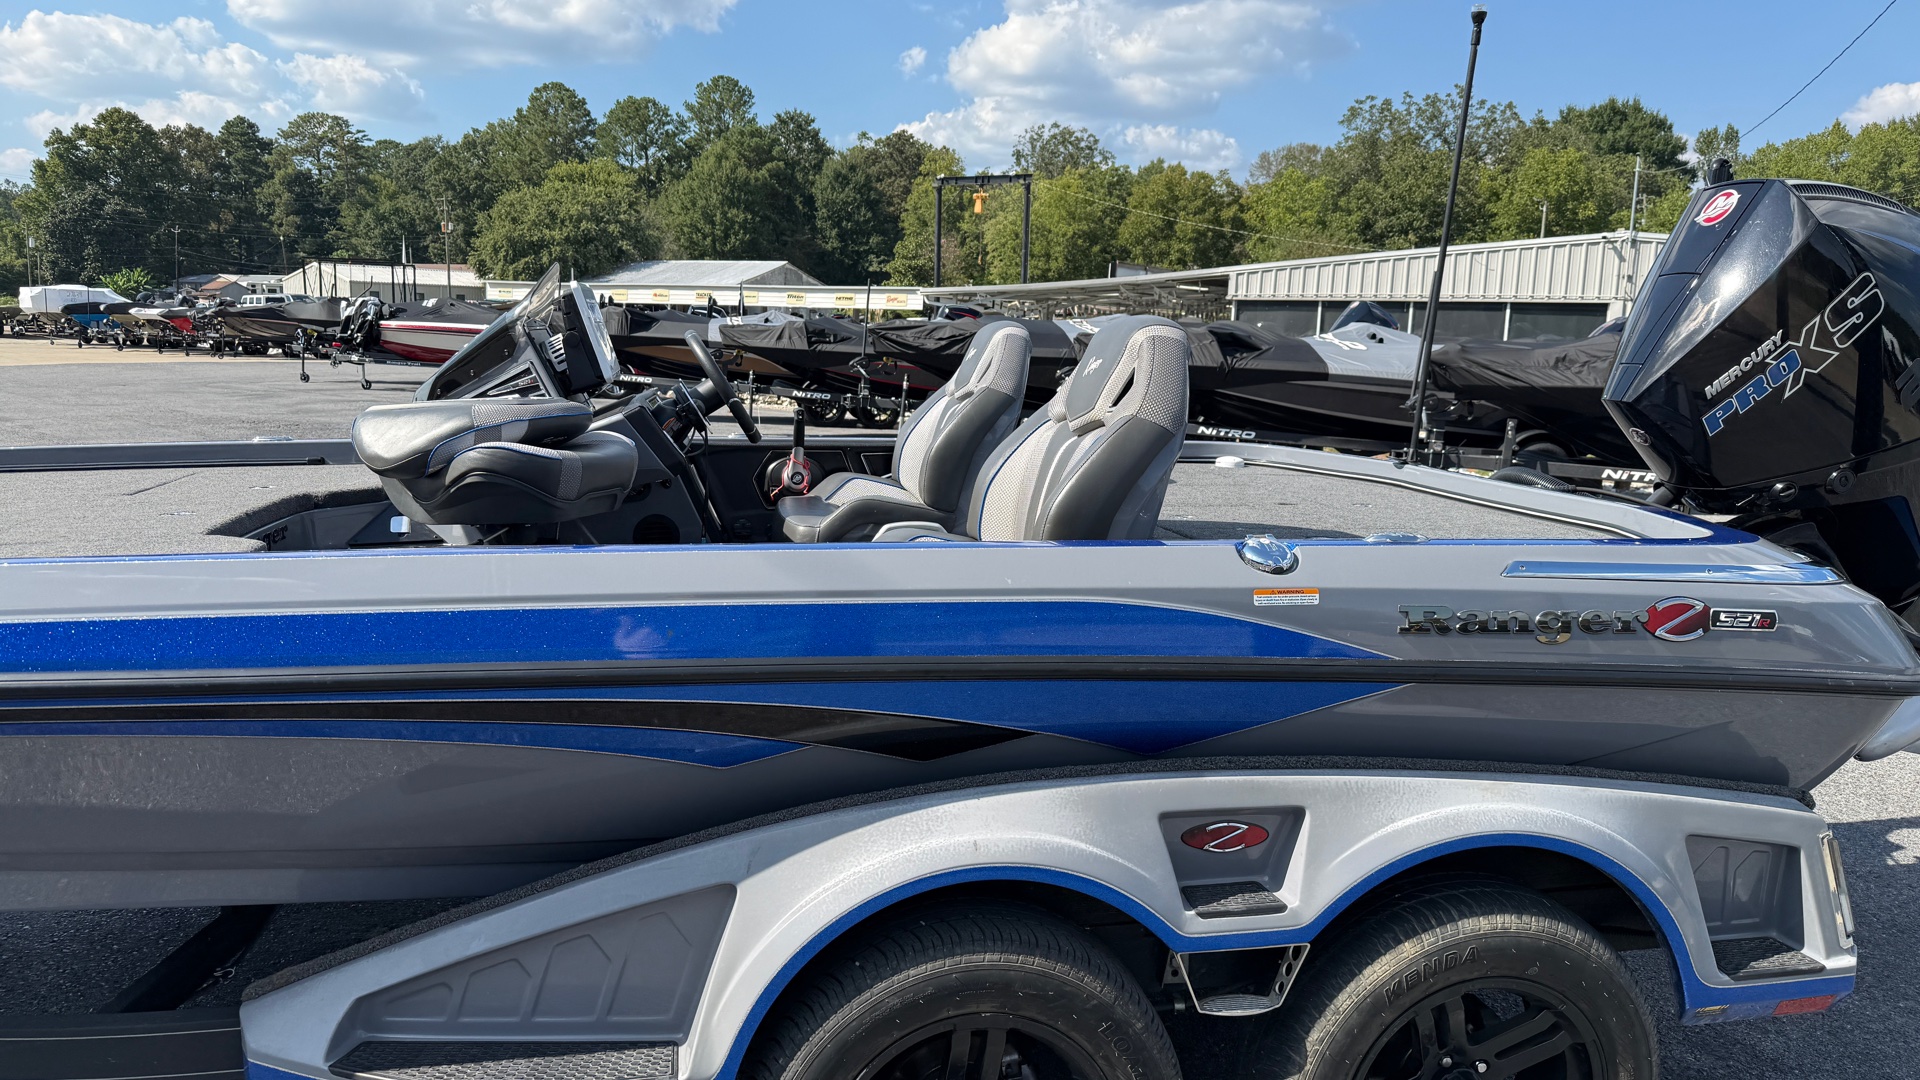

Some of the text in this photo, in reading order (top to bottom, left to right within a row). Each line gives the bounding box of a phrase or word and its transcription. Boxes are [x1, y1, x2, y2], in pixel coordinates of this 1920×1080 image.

[1704, 329, 1784, 400] MERCURY
[1397, 604, 1650, 645] Ranger
[1383, 944, 1479, 1007] KENDA
